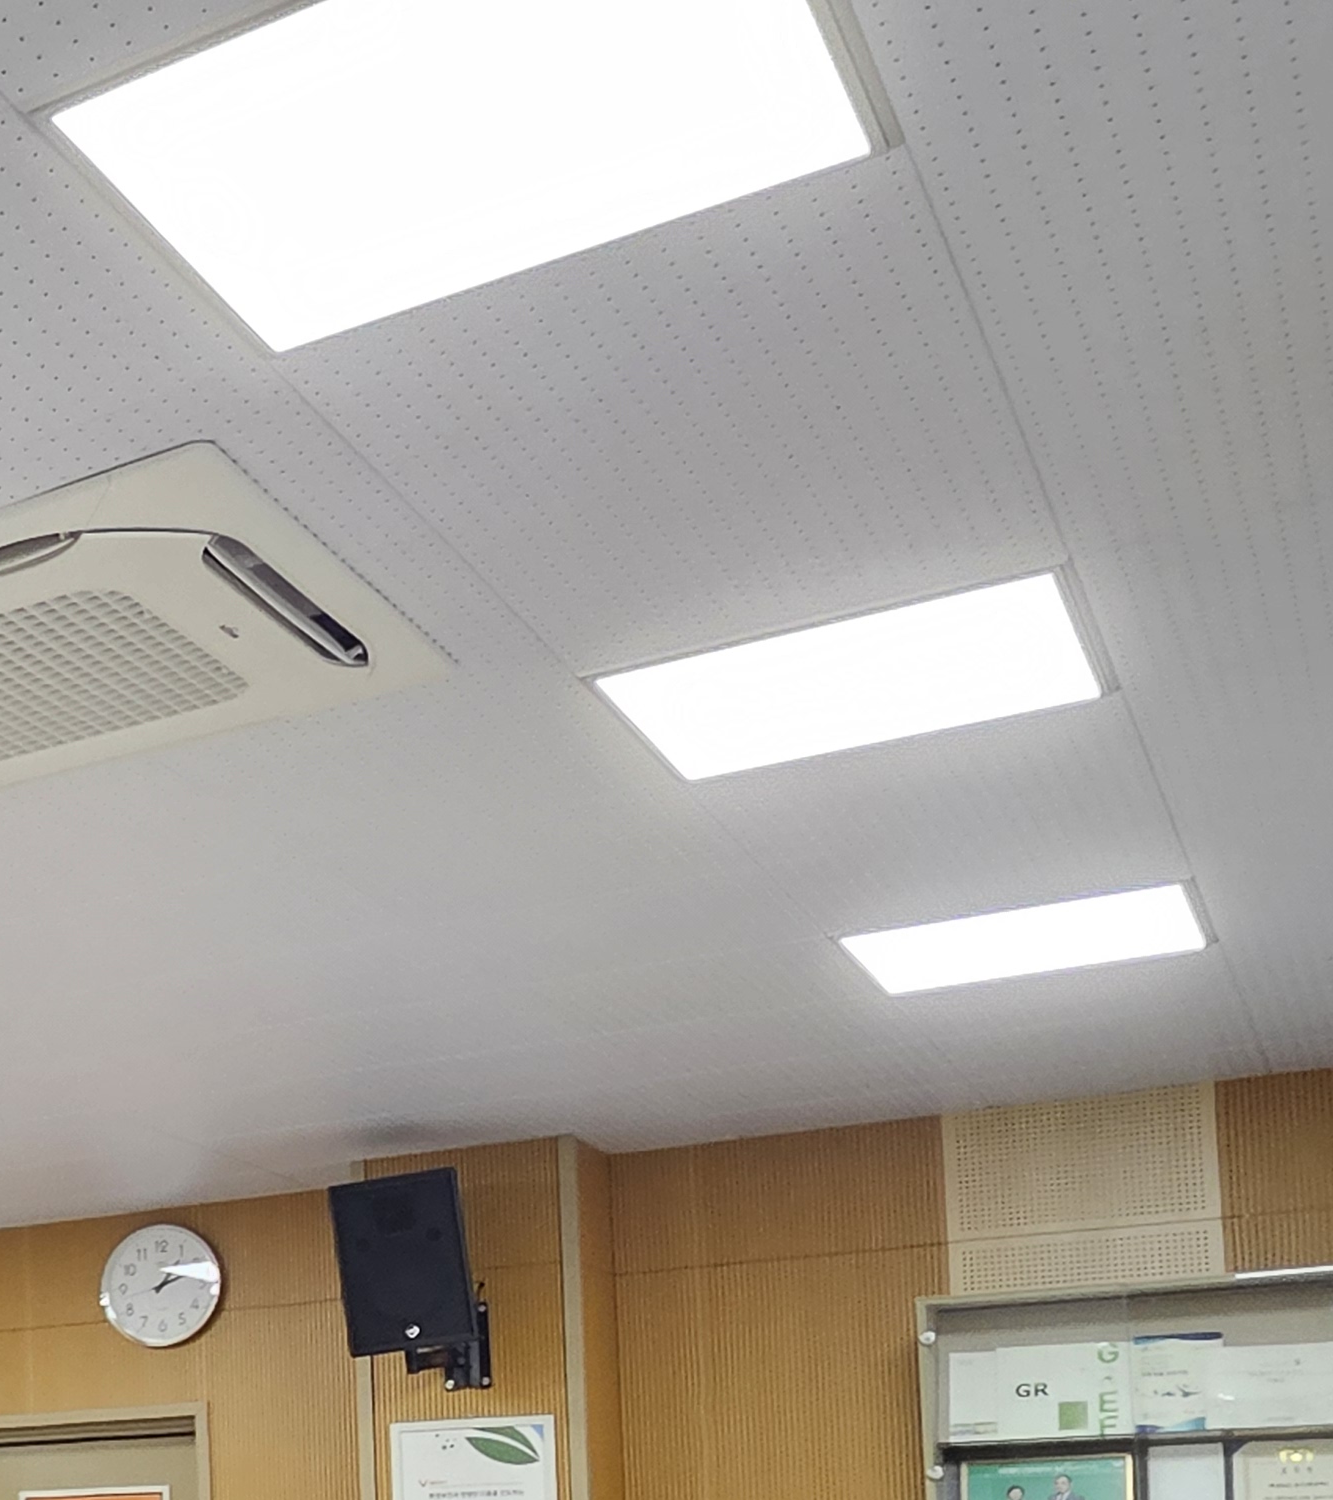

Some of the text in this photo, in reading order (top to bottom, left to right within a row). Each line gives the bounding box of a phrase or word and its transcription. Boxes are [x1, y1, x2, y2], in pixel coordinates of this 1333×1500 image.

[155, 1240, 168, 1252] 12
[136, 1248, 147, 1261] 11
[118, 1283, 128, 1295] 9
[126, 1303, 134, 1316] 8
[190, 1298, 199, 1309] 4
[139, 1316, 148, 1327] 7
[178, 1312, 186, 1325] 5
[158, 1319, 167, 1332] 6
[1015, 1382, 1049, 1397] GR
